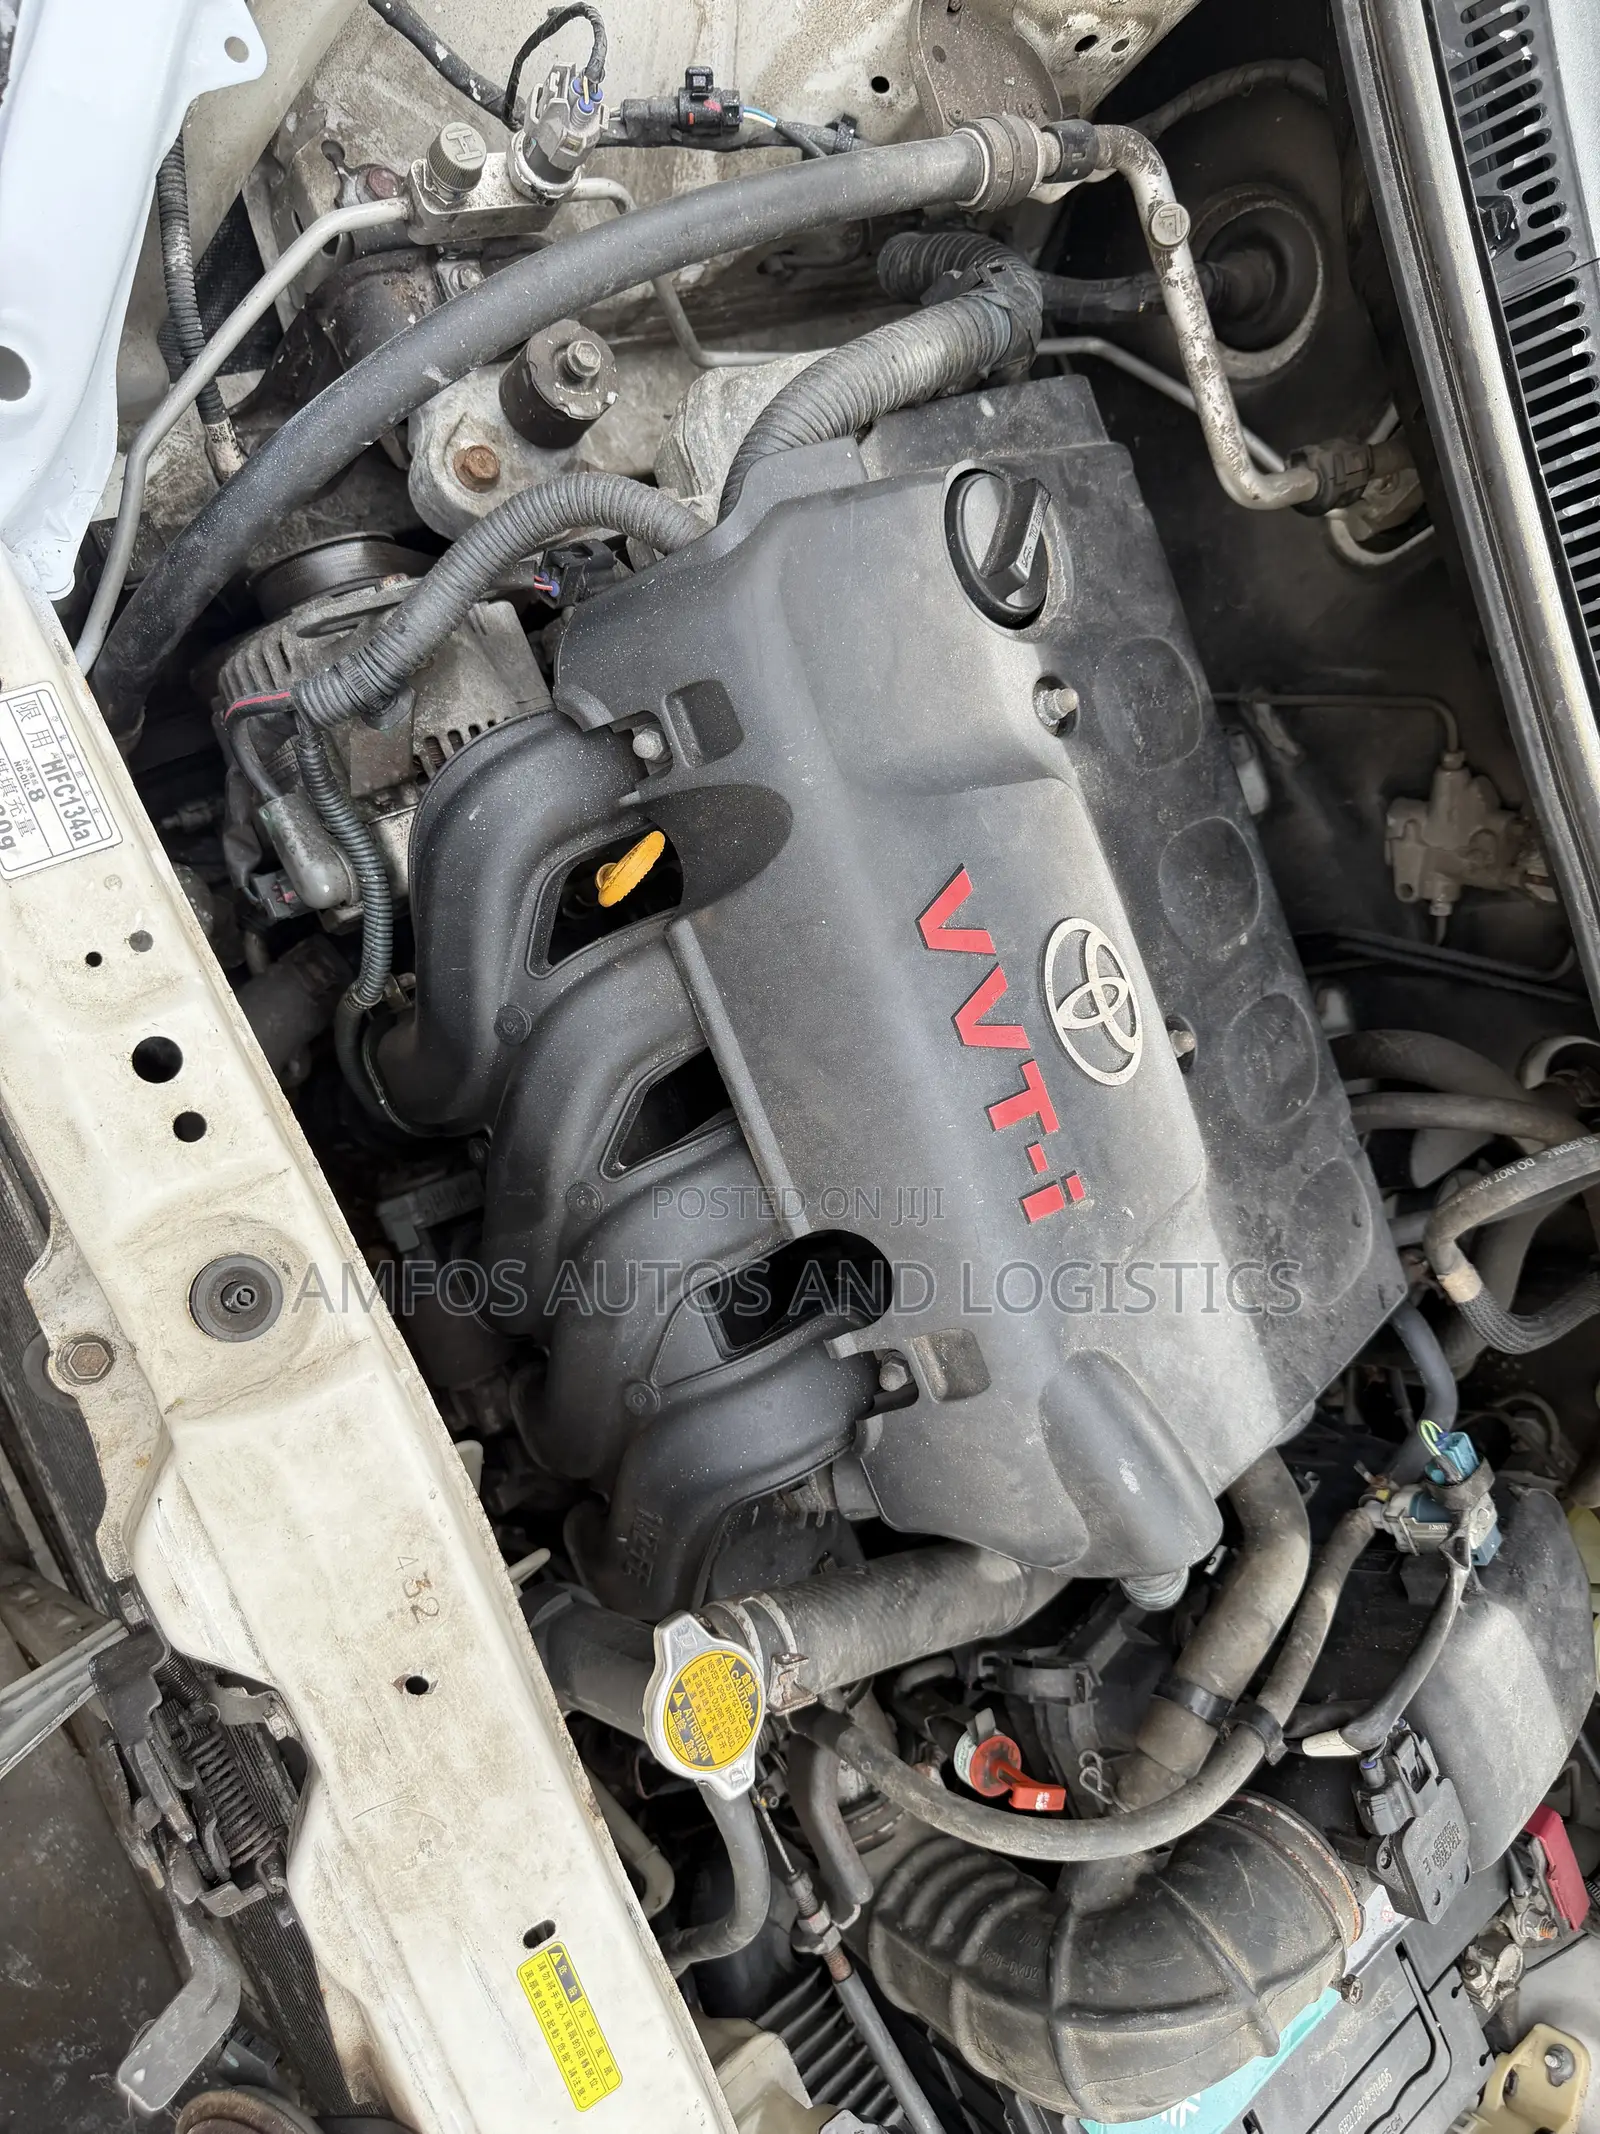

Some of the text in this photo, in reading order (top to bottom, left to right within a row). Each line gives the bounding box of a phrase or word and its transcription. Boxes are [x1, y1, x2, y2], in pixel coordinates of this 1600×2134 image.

[13, 700, 55, 749] 限用
[41, 758, 92, 842] HFC134a
[915, 862, 1086, 1225] VVT-i
[1494, 1168, 1517, 1183] NOT
[1517, 1157, 1536, 1171] DO
[703, 1675, 716, 1698] JAMAIS
[711, 1699, 725, 1720] OUVRIR
[707, 1659, 719, 1683] NEVER
[716, 1684, 727, 1704] OPEN
[725, 1706, 737, 1725] WHEN
[730, 1669, 755, 1721] CAUTION
[683, 1708, 711, 1762] ATTENTION
